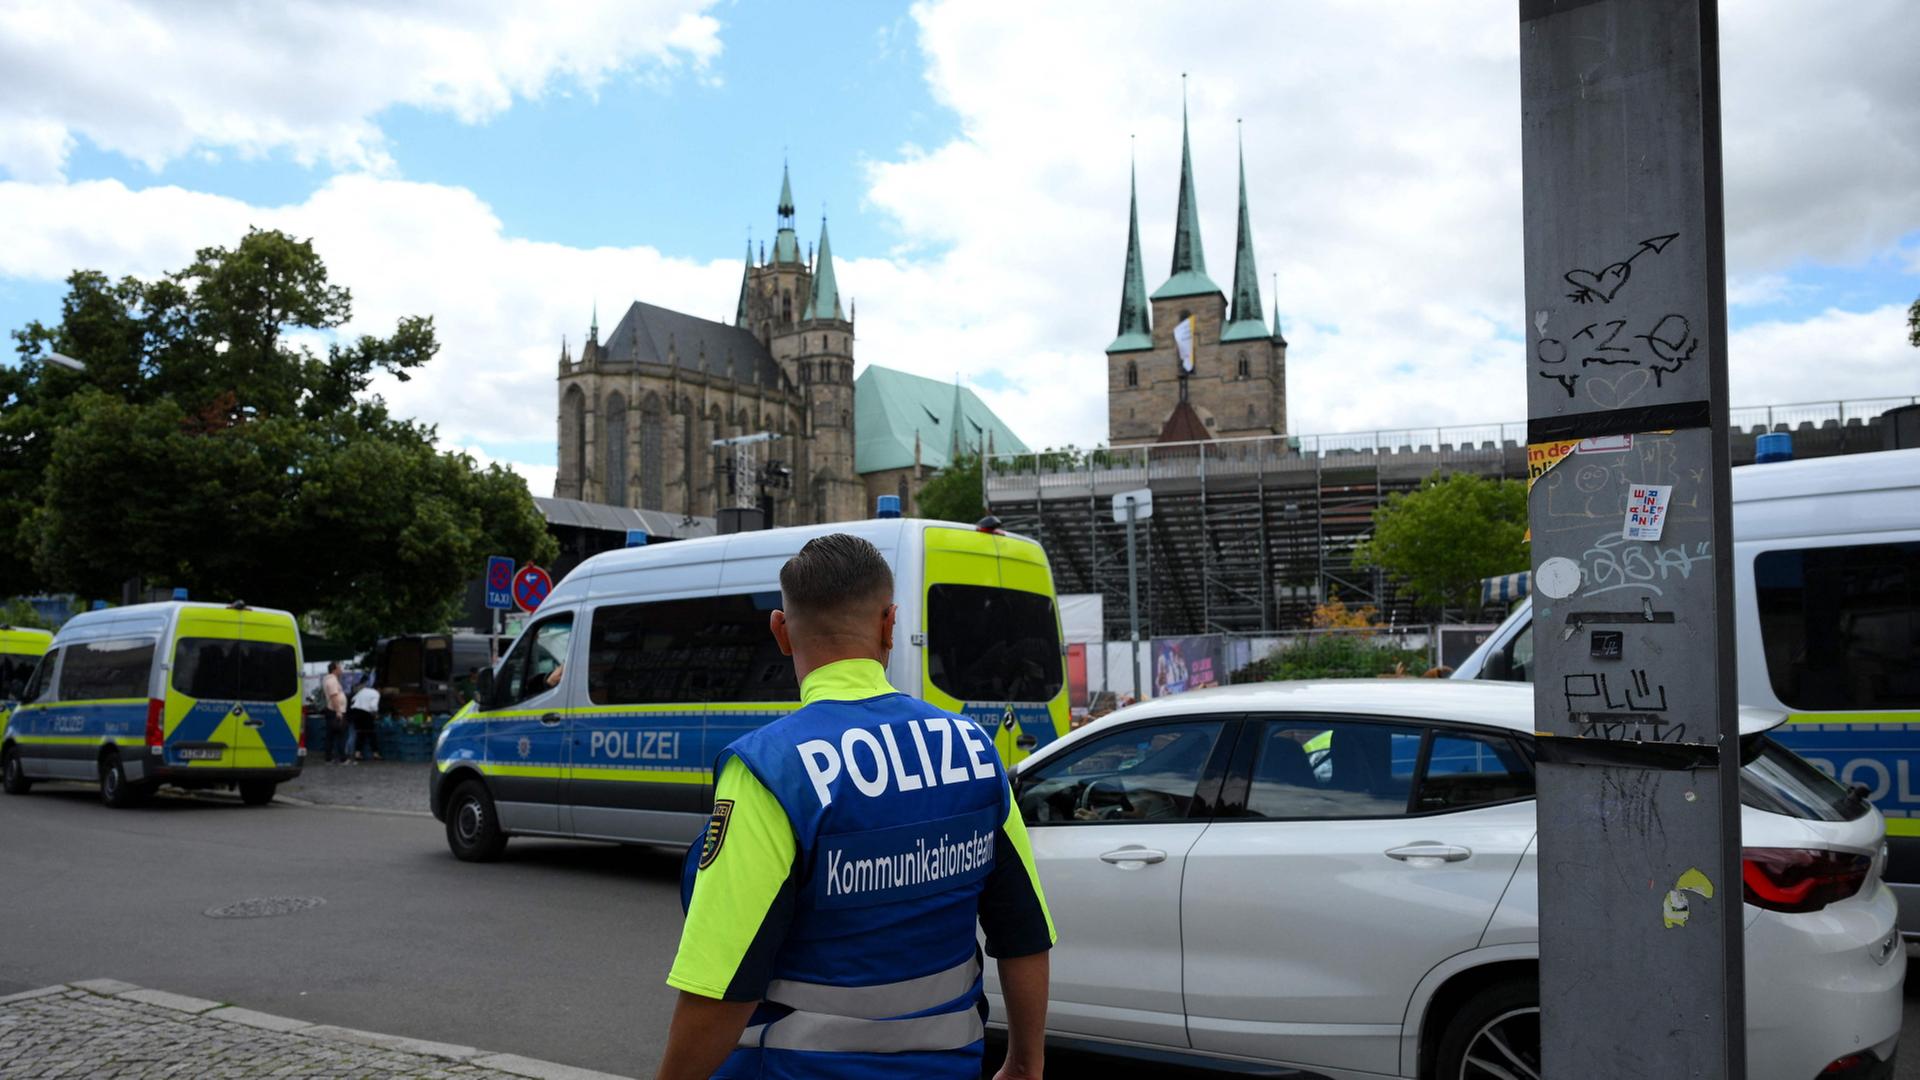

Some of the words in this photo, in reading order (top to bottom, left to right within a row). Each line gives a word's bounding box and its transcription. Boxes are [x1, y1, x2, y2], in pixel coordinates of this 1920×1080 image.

[1548, 443, 1575, 457] de
[488, 591, 510, 604] TAXI
[966, 712, 1000, 726] OLIZEI
[590, 730, 680, 760] POLIZEI
[796, 718, 996, 809] POLIZE
[826, 830, 995, 896] Kommunikationsteam
